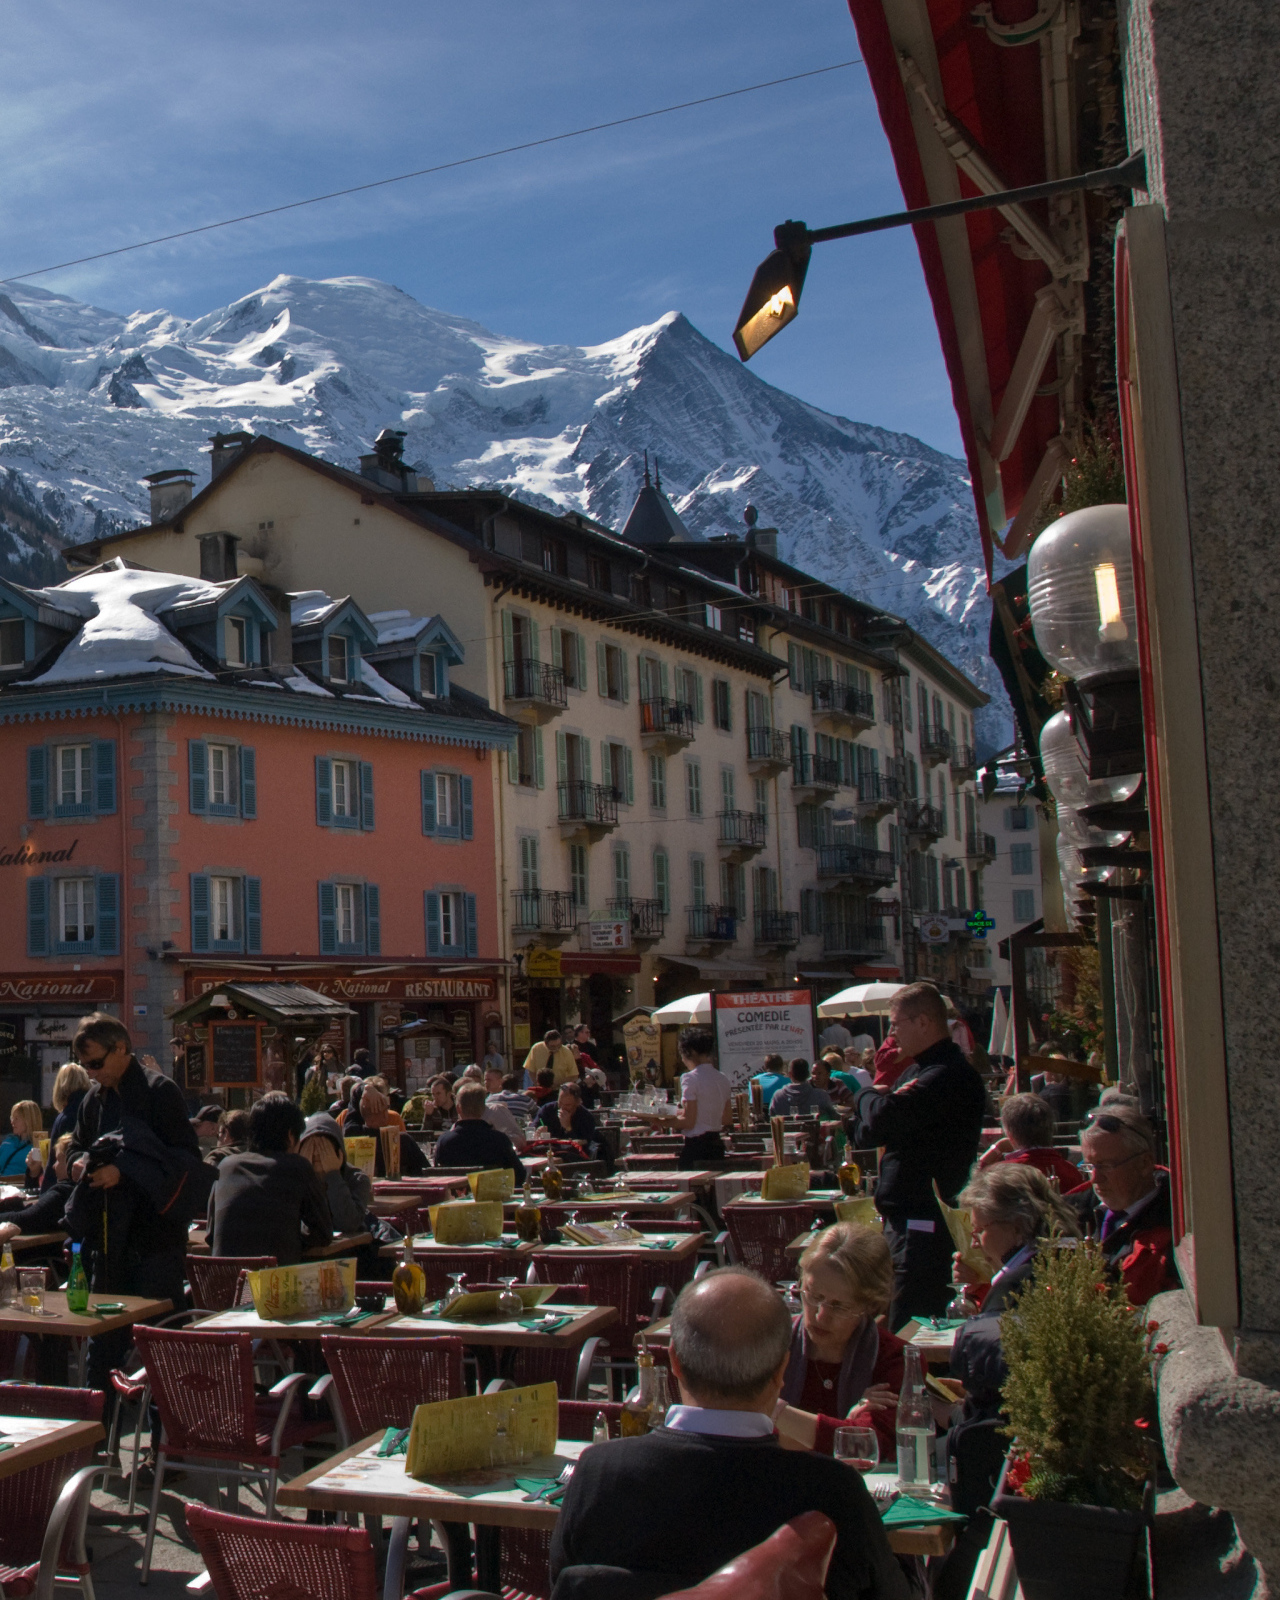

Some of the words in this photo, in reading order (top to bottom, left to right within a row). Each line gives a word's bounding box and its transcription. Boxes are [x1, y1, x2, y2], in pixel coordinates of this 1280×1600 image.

[330, 980, 392, 998] National
[405, 979, 491, 998] RESTAURANT
[737, 1010, 791, 1023] COMEDIE
